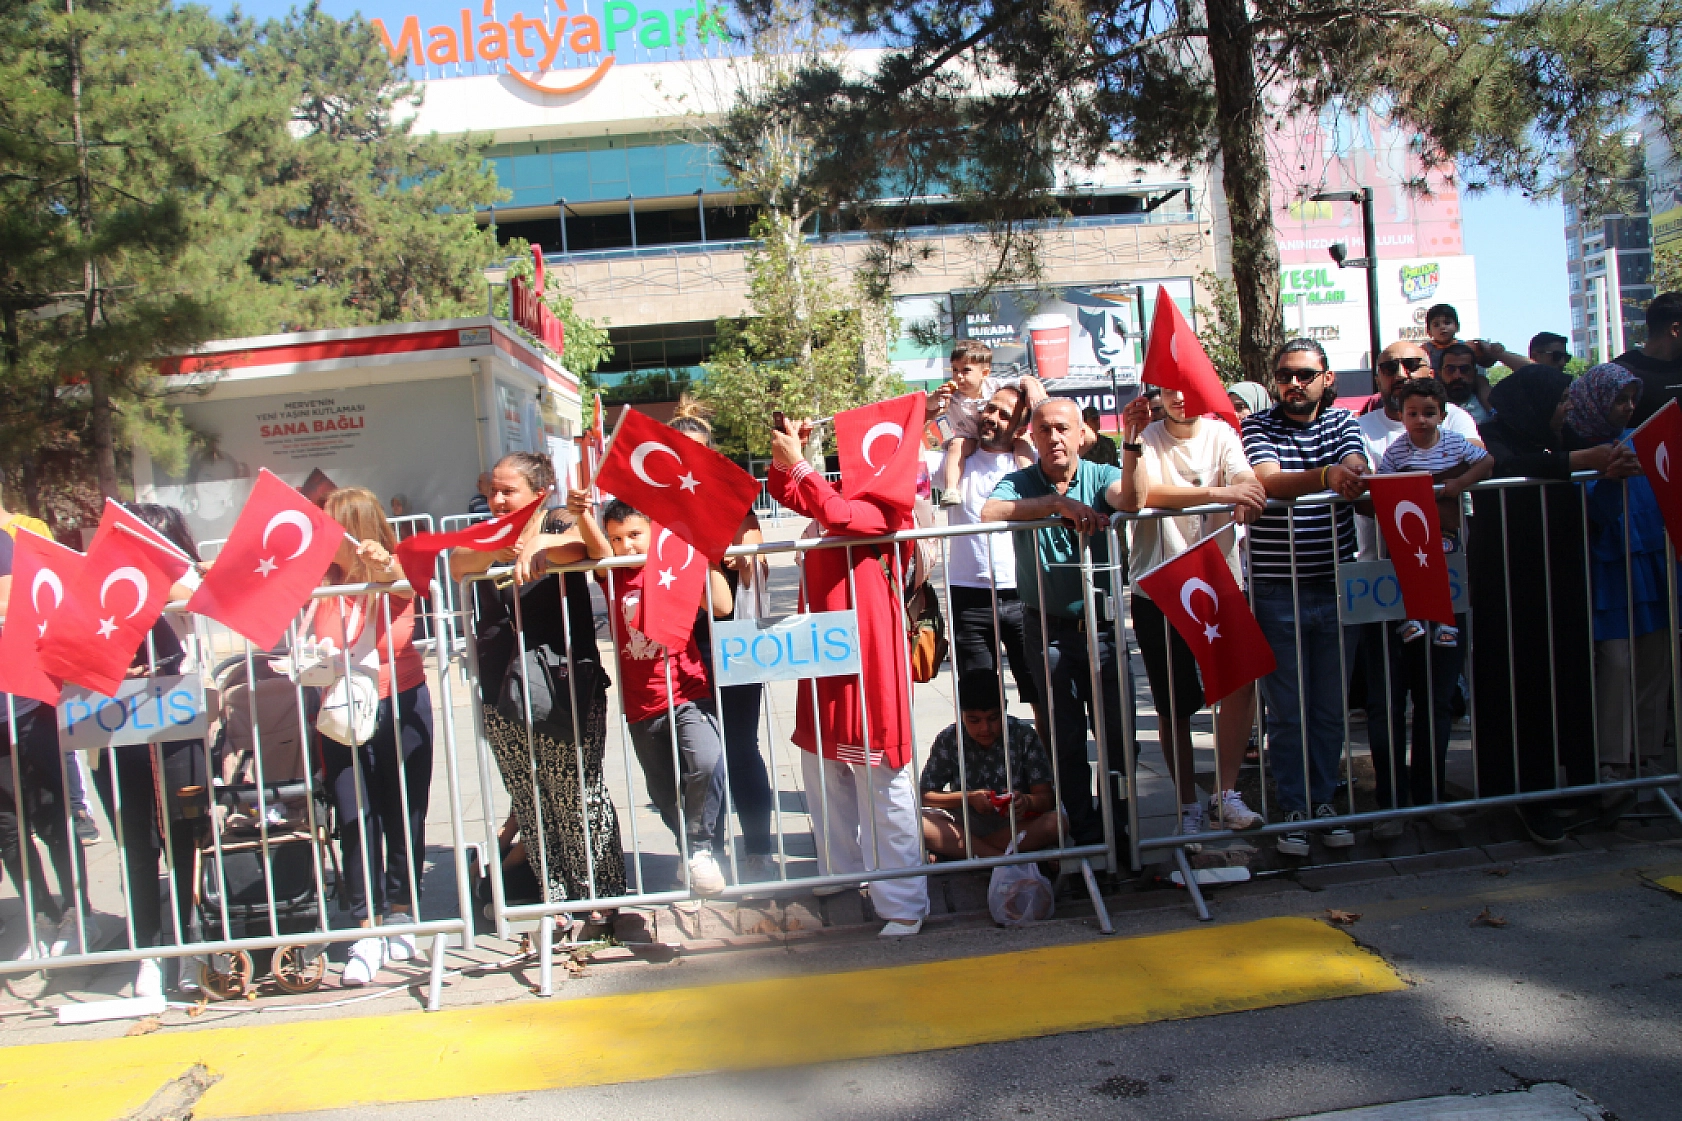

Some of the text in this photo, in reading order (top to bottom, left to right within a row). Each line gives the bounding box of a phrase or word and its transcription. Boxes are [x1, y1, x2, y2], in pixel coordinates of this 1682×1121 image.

[260, 421, 309, 438] SANA
[313, 415, 364, 433] BAĞLI
[312, 404, 365, 416] KUTLAMASI
[1346, 569, 1462, 612] POS
[720, 622, 851, 671] POLİS
[65, 686, 197, 736] POLİS
